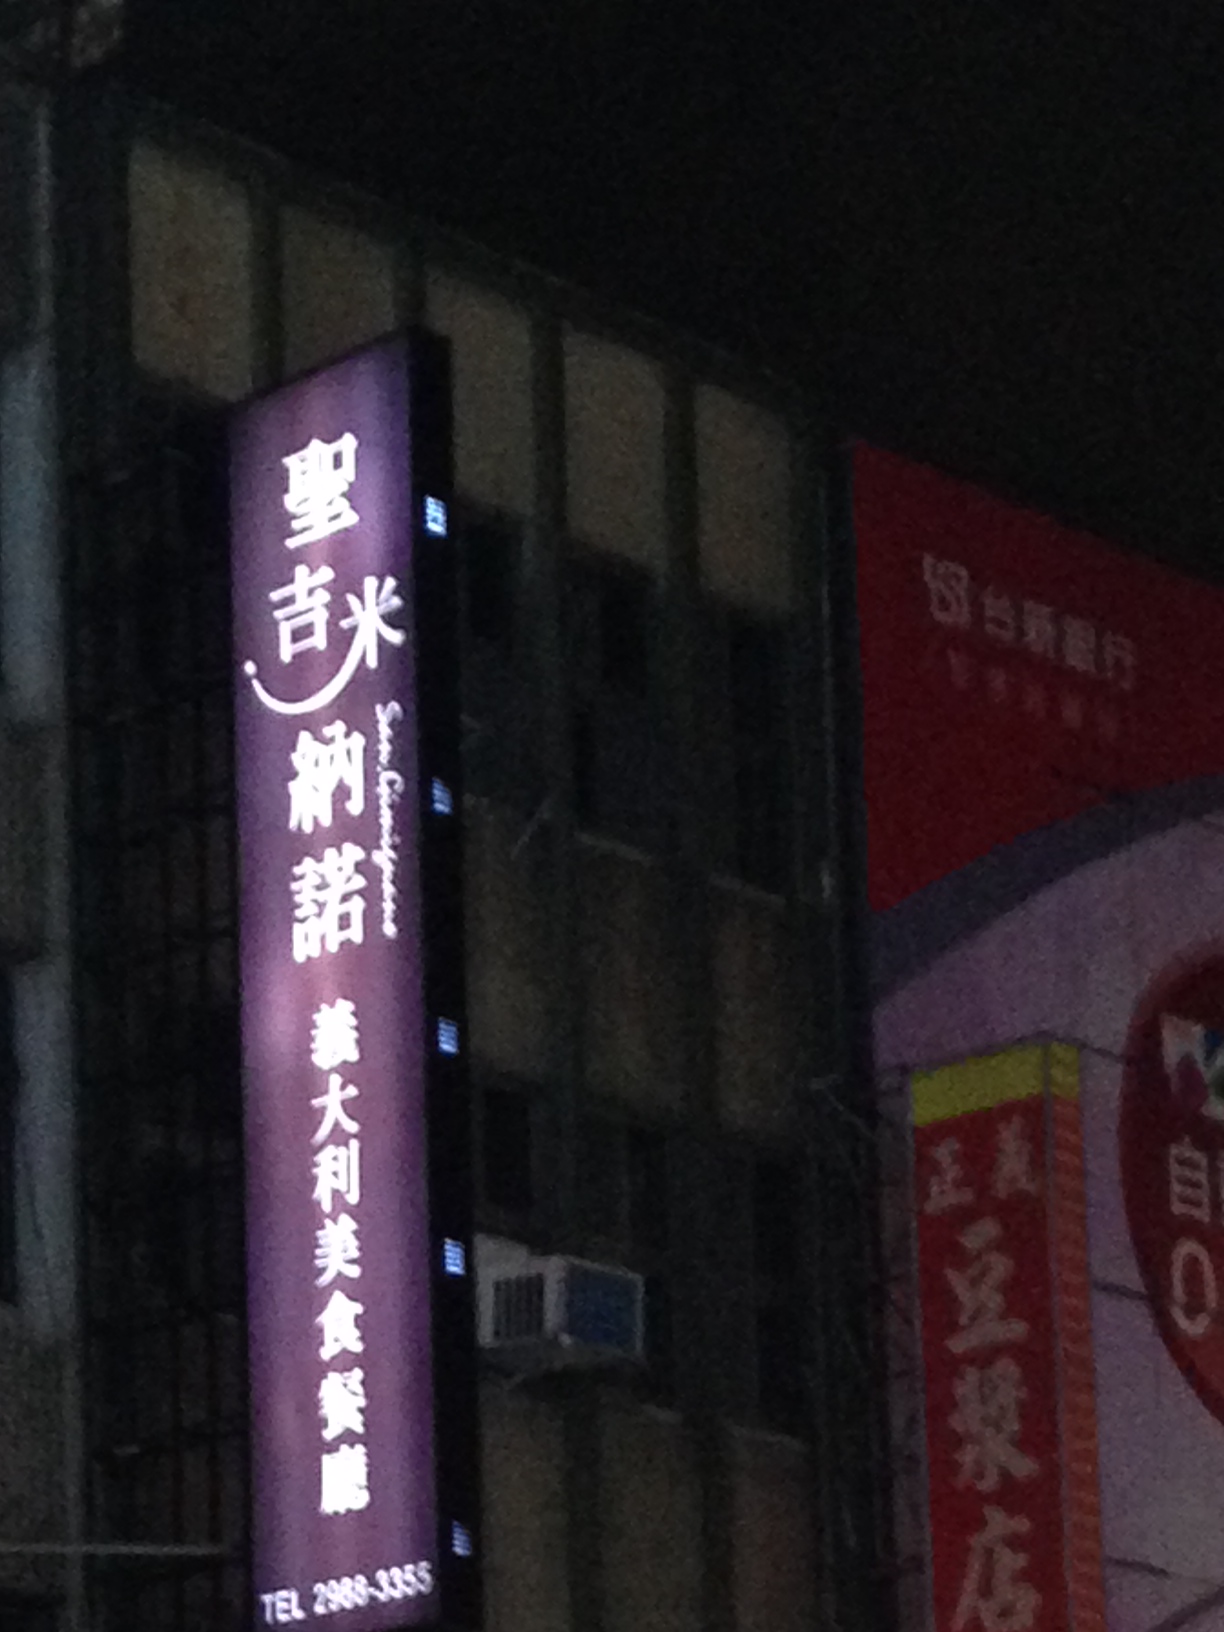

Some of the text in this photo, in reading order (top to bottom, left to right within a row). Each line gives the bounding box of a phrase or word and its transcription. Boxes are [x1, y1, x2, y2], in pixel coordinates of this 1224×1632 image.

[244, 432, 406, 963] 聖吉米納諾
[310, 998, 371, 1516] 義大利美食餐廳
[260, 1587, 306, 1625] TEL
